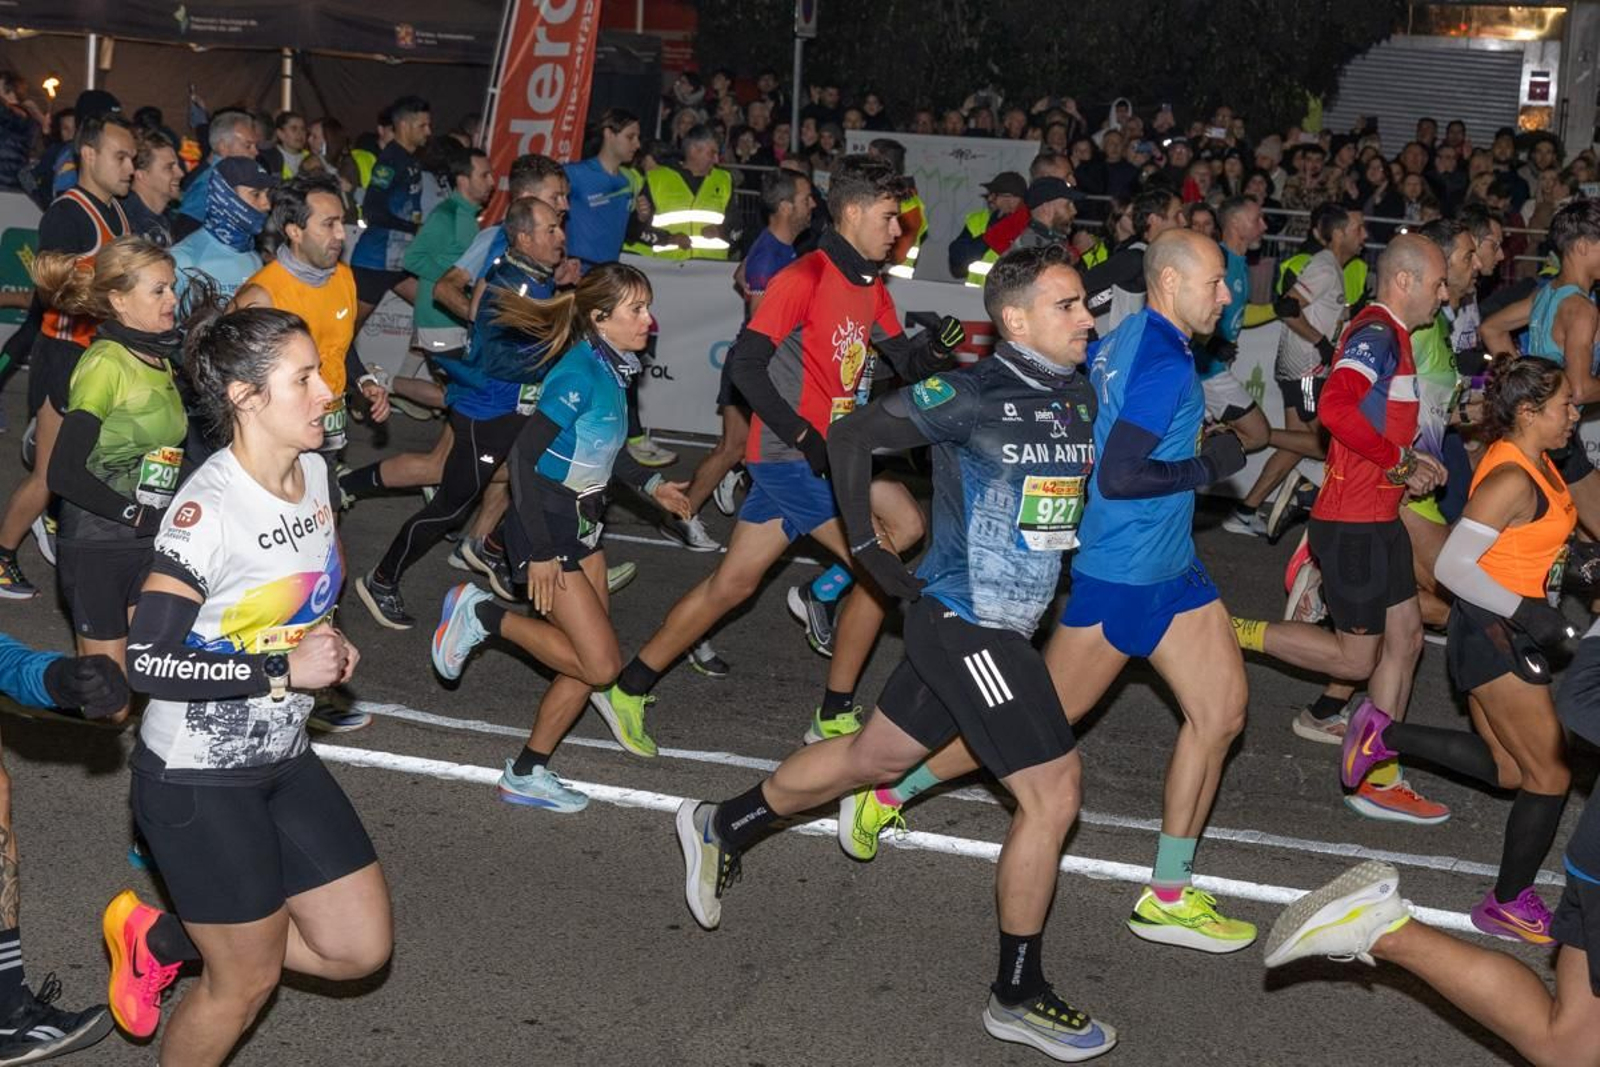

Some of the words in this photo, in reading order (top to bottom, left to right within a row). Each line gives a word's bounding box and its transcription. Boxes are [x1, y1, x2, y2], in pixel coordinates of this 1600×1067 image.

[1002, 443, 1049, 464] SAN
[1037, 497, 1079, 524] 927
[258, 499, 332, 553] calderón
[133, 652, 252, 681] entrénate
